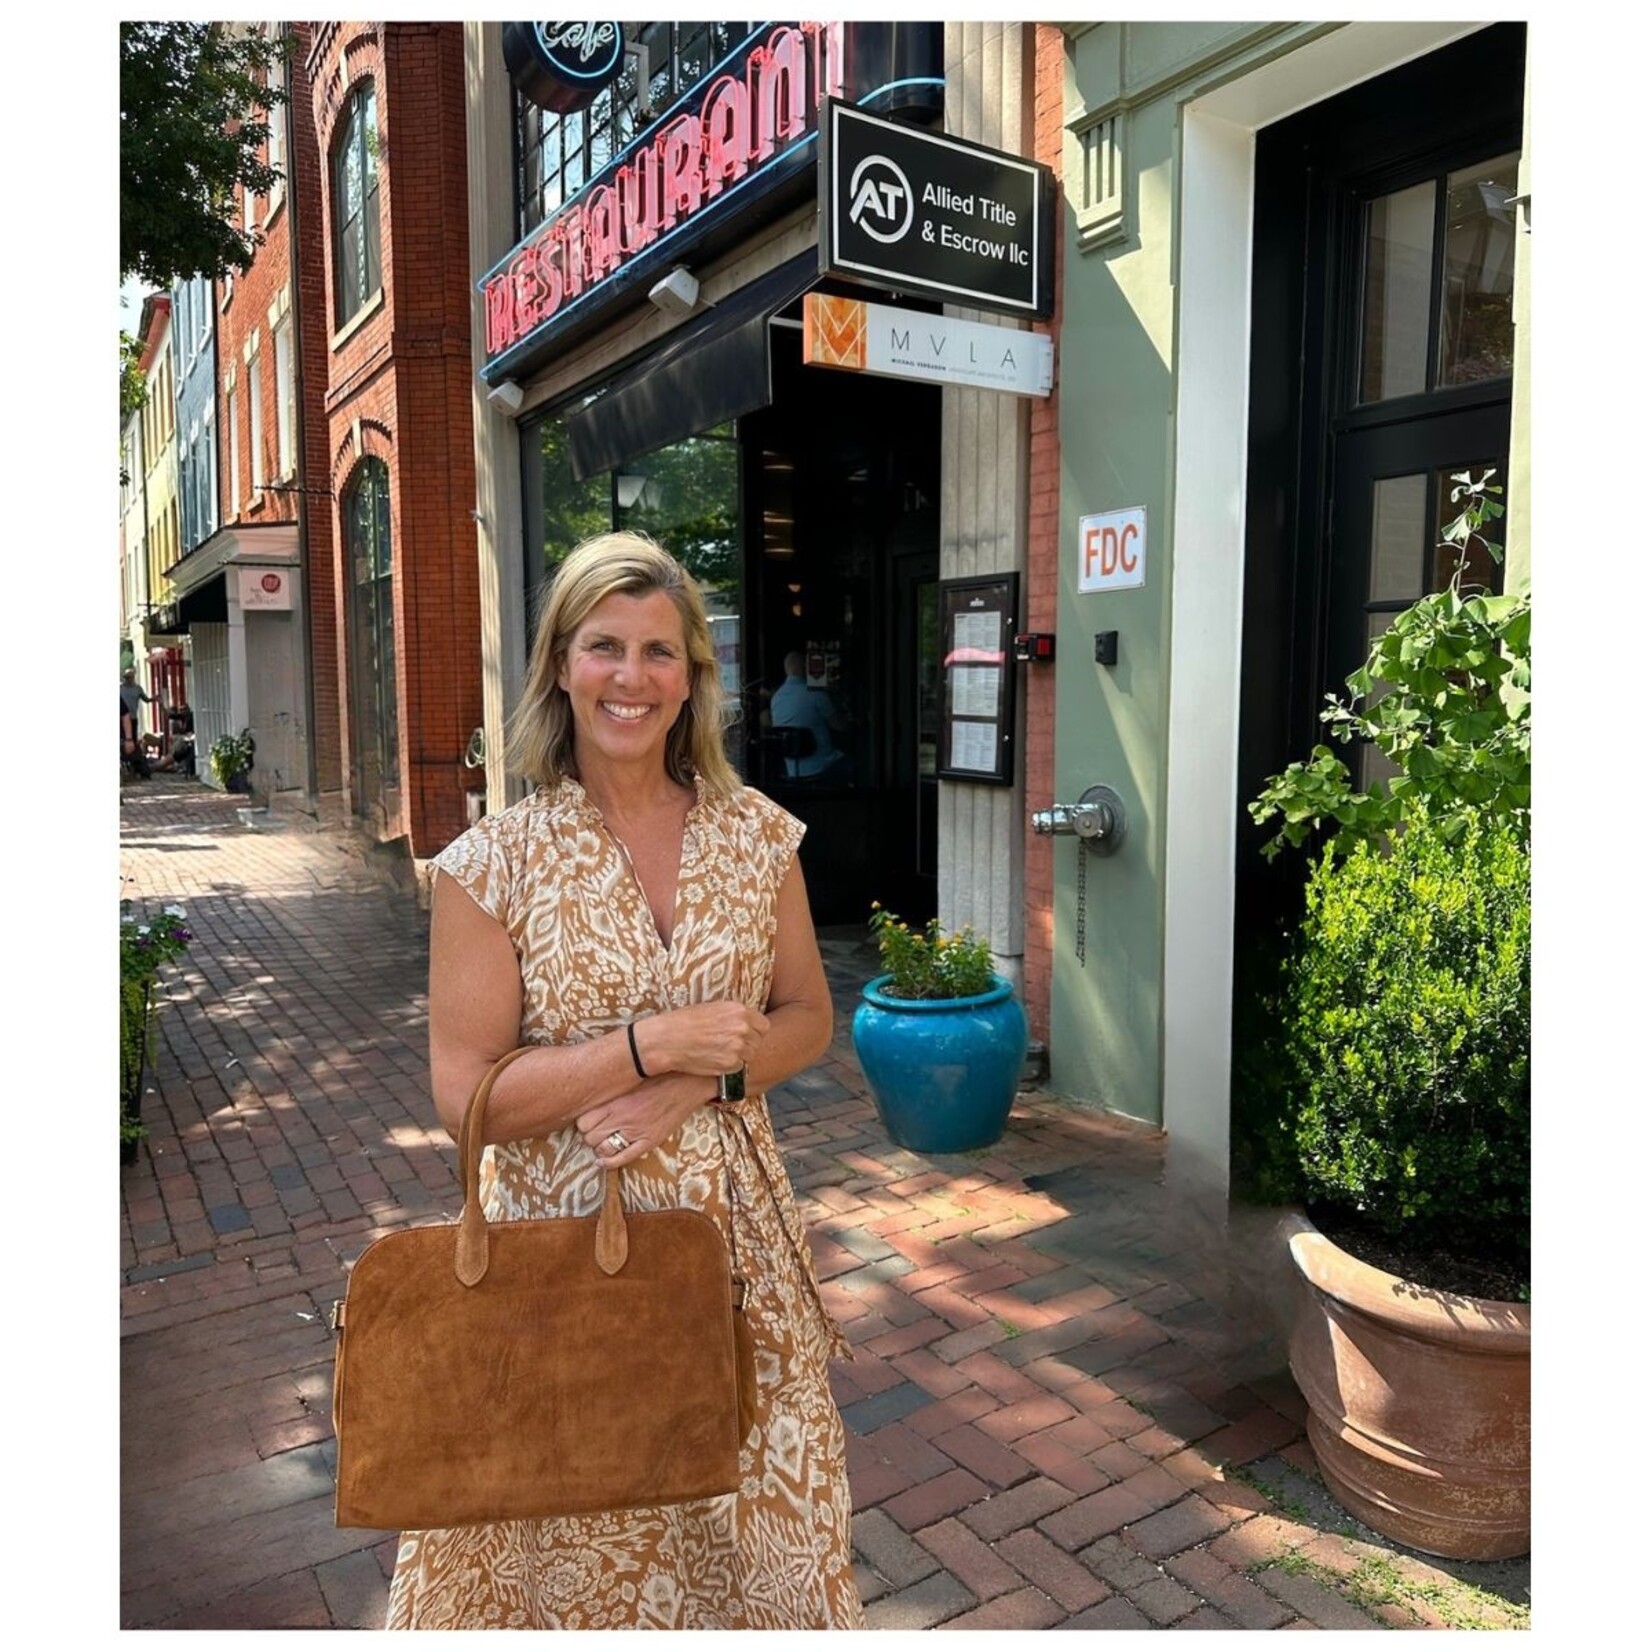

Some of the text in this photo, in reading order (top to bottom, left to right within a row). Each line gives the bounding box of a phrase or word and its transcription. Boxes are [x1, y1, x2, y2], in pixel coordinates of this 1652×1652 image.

[922, 182, 1017, 226] Allied Title
[921, 220, 936, 244] &
[941, 224, 1005, 260] Escrow
[1084, 523, 1138, 579] FDC
